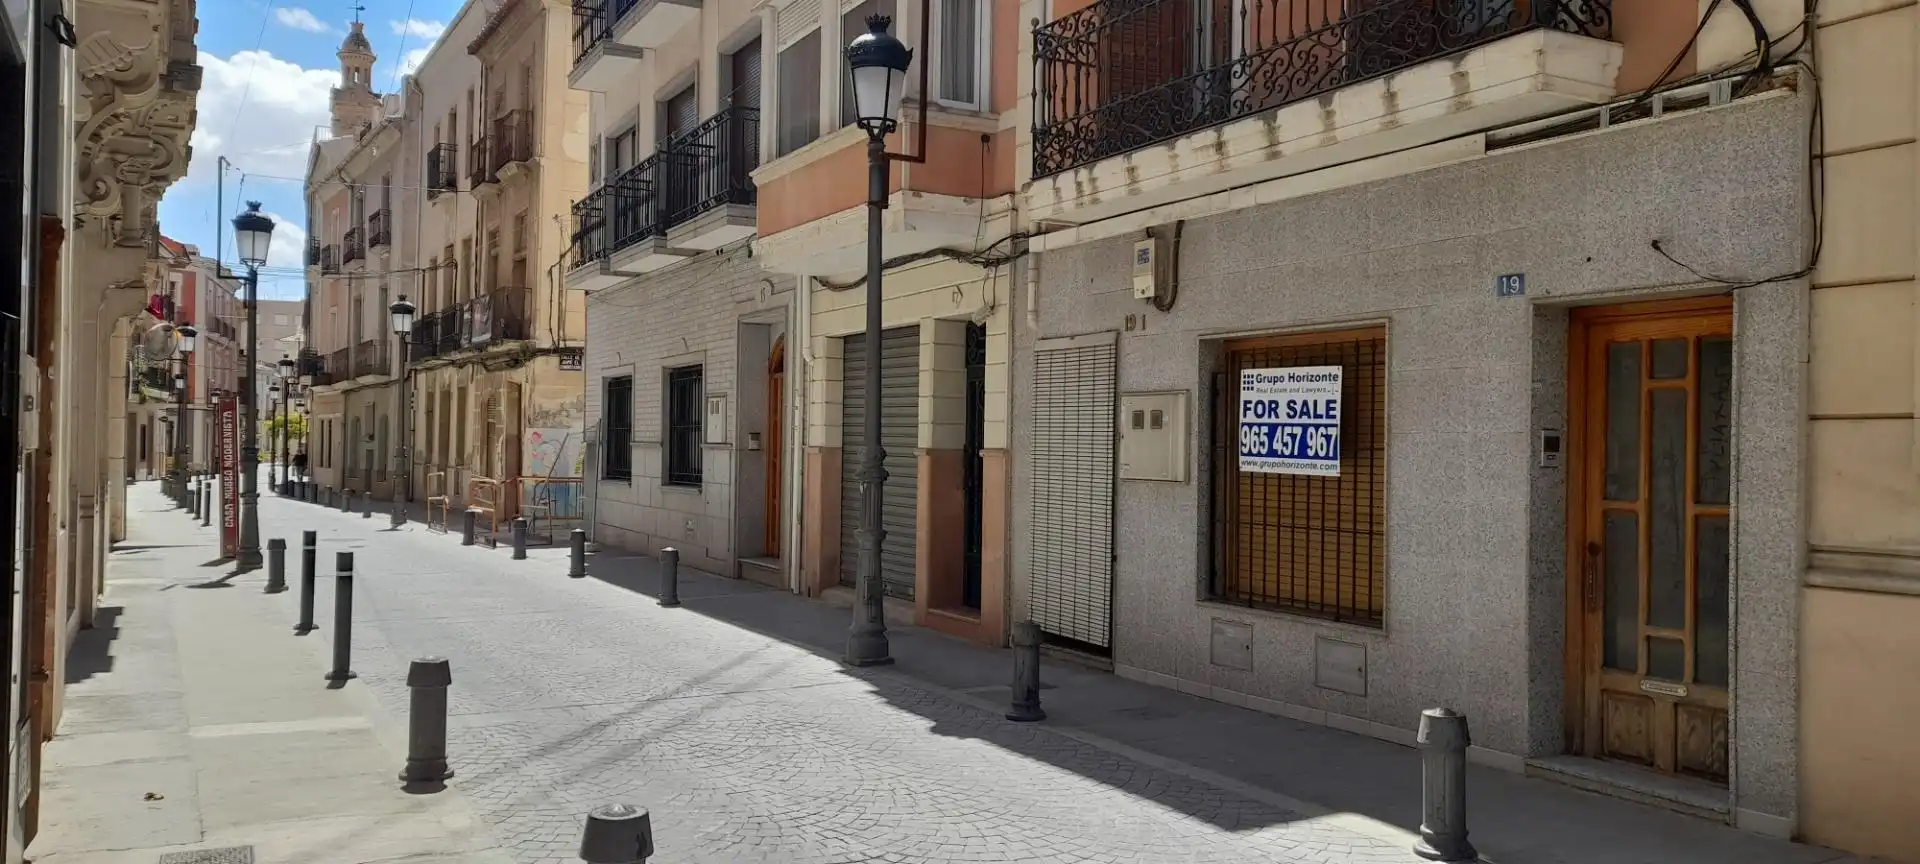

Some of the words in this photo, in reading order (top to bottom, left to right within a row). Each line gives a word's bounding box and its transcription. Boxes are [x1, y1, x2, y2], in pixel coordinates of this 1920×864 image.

[1502, 276, 1520, 295] 19
[1256, 374, 1285, 385] Grupo
[1288, 372, 1339, 383] Horizonte
[1243, 400, 1280, 419] FOR
[1286, 400, 1337, 419] SALE
[223, 411, 233, 468] MODERNISTA
[1241, 425, 1269, 454] 965
[1272, 426, 1303, 456] 457
[1306, 426, 1338, 457] 967
[1241, 460, 1338, 470] www.grupohorizonte.com
